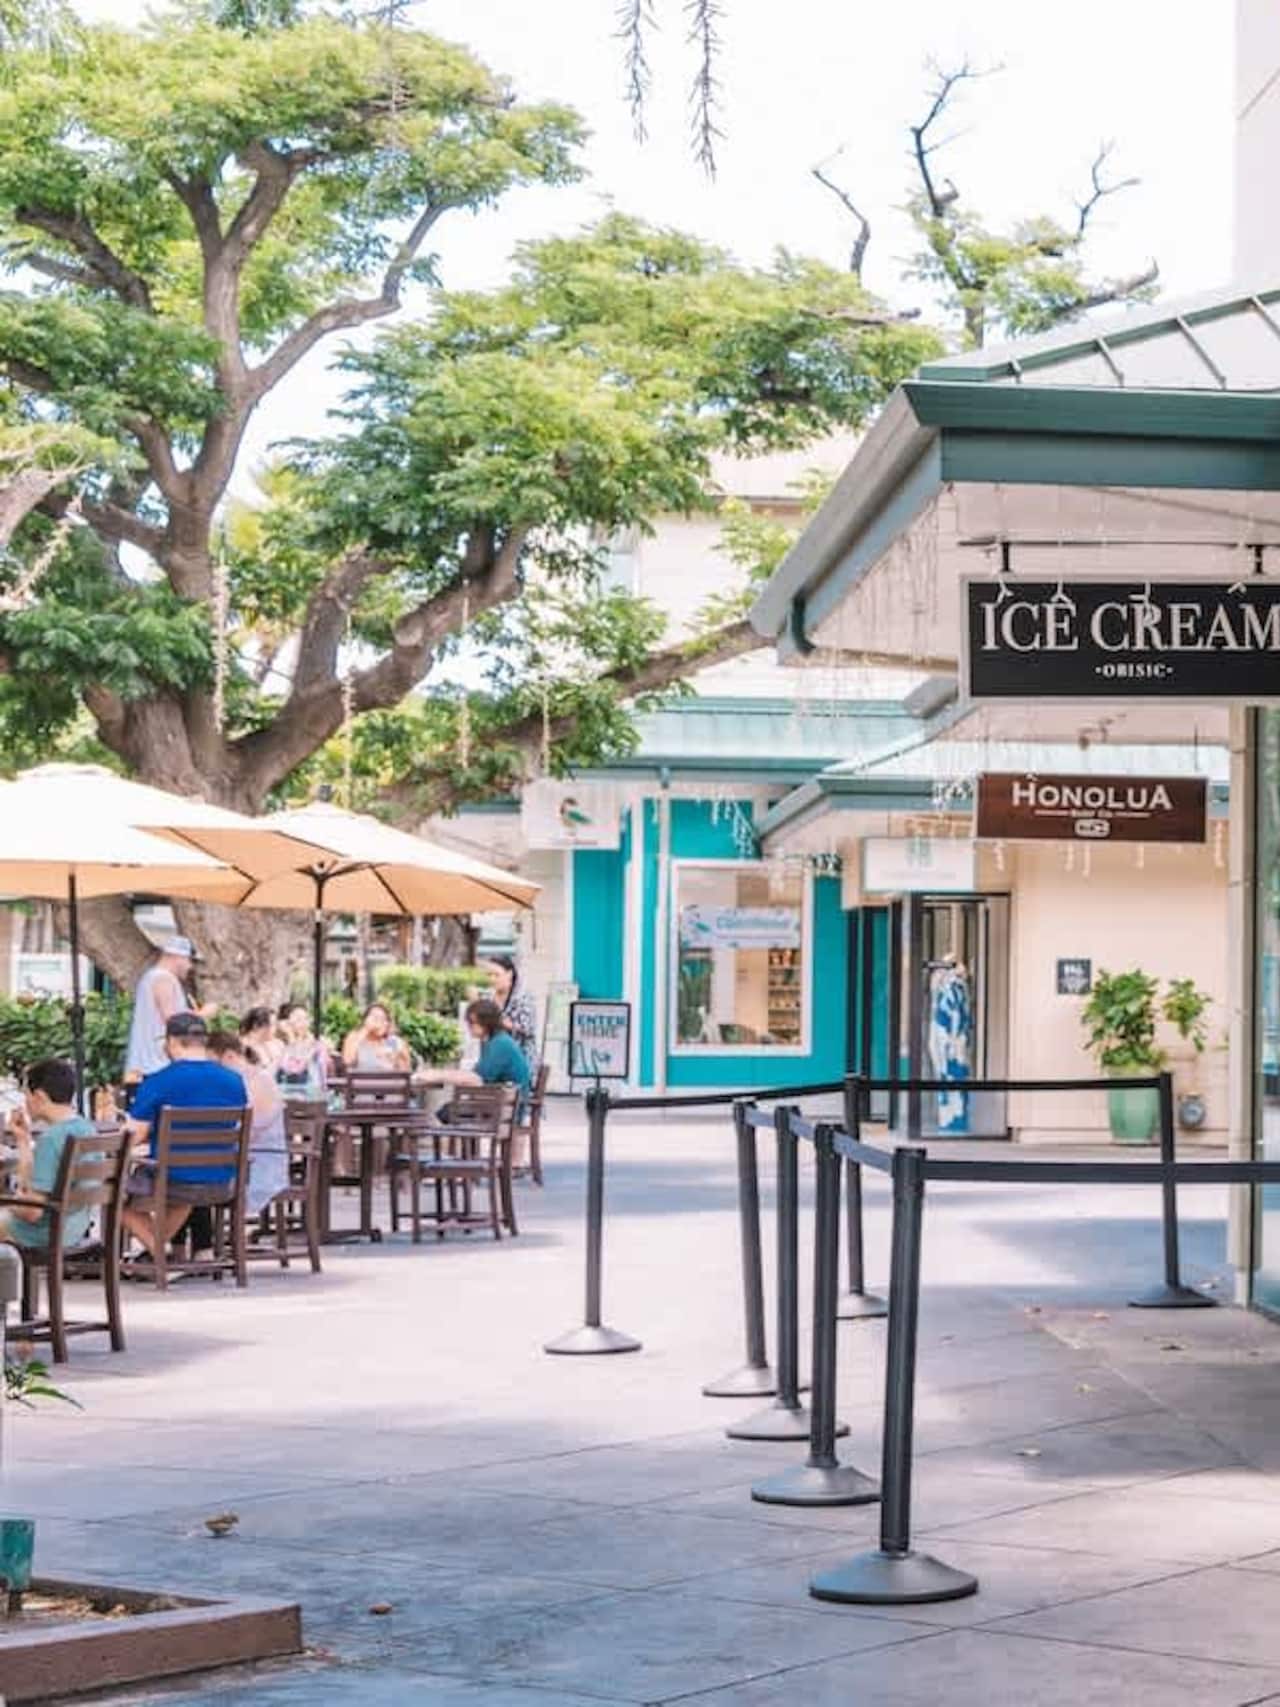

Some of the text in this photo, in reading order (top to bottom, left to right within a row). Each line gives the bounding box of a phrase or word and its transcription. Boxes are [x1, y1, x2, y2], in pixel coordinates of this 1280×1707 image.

[979, 602, 1079, 651] ICE
[1012, 781, 1173, 811] HONOLUA
[577, 1013, 626, 1025] ENTER
